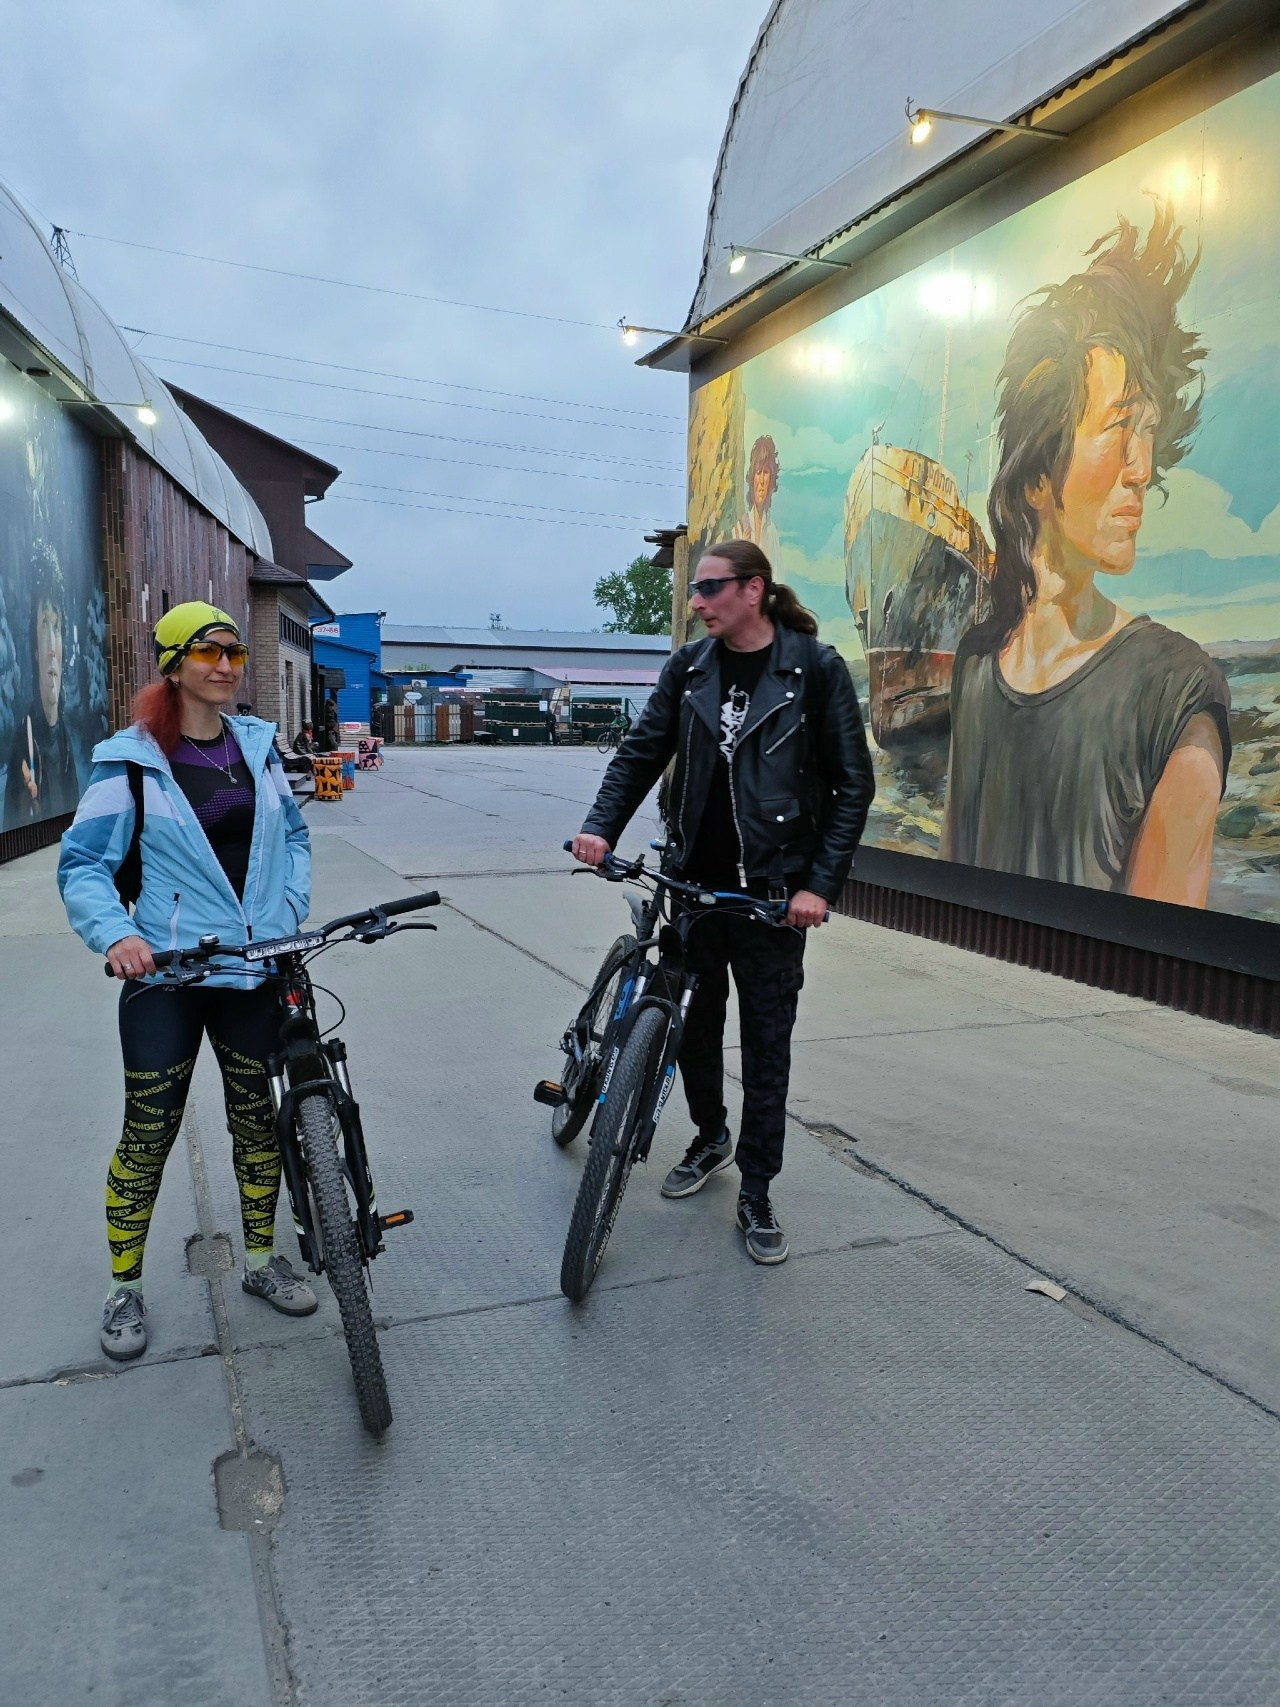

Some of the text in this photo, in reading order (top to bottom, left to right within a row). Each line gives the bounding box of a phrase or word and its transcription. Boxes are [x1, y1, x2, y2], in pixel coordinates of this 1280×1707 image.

[125, 1070, 160, 1079] ANGER
[133, 1081, 173, 1098] DANGER
[131, 1099, 165, 1116] ANGER
[129, 1120, 166, 1130] DANGER
[128, 1143, 146, 1151] OUT
[118, 1176, 155, 1188] NGER
